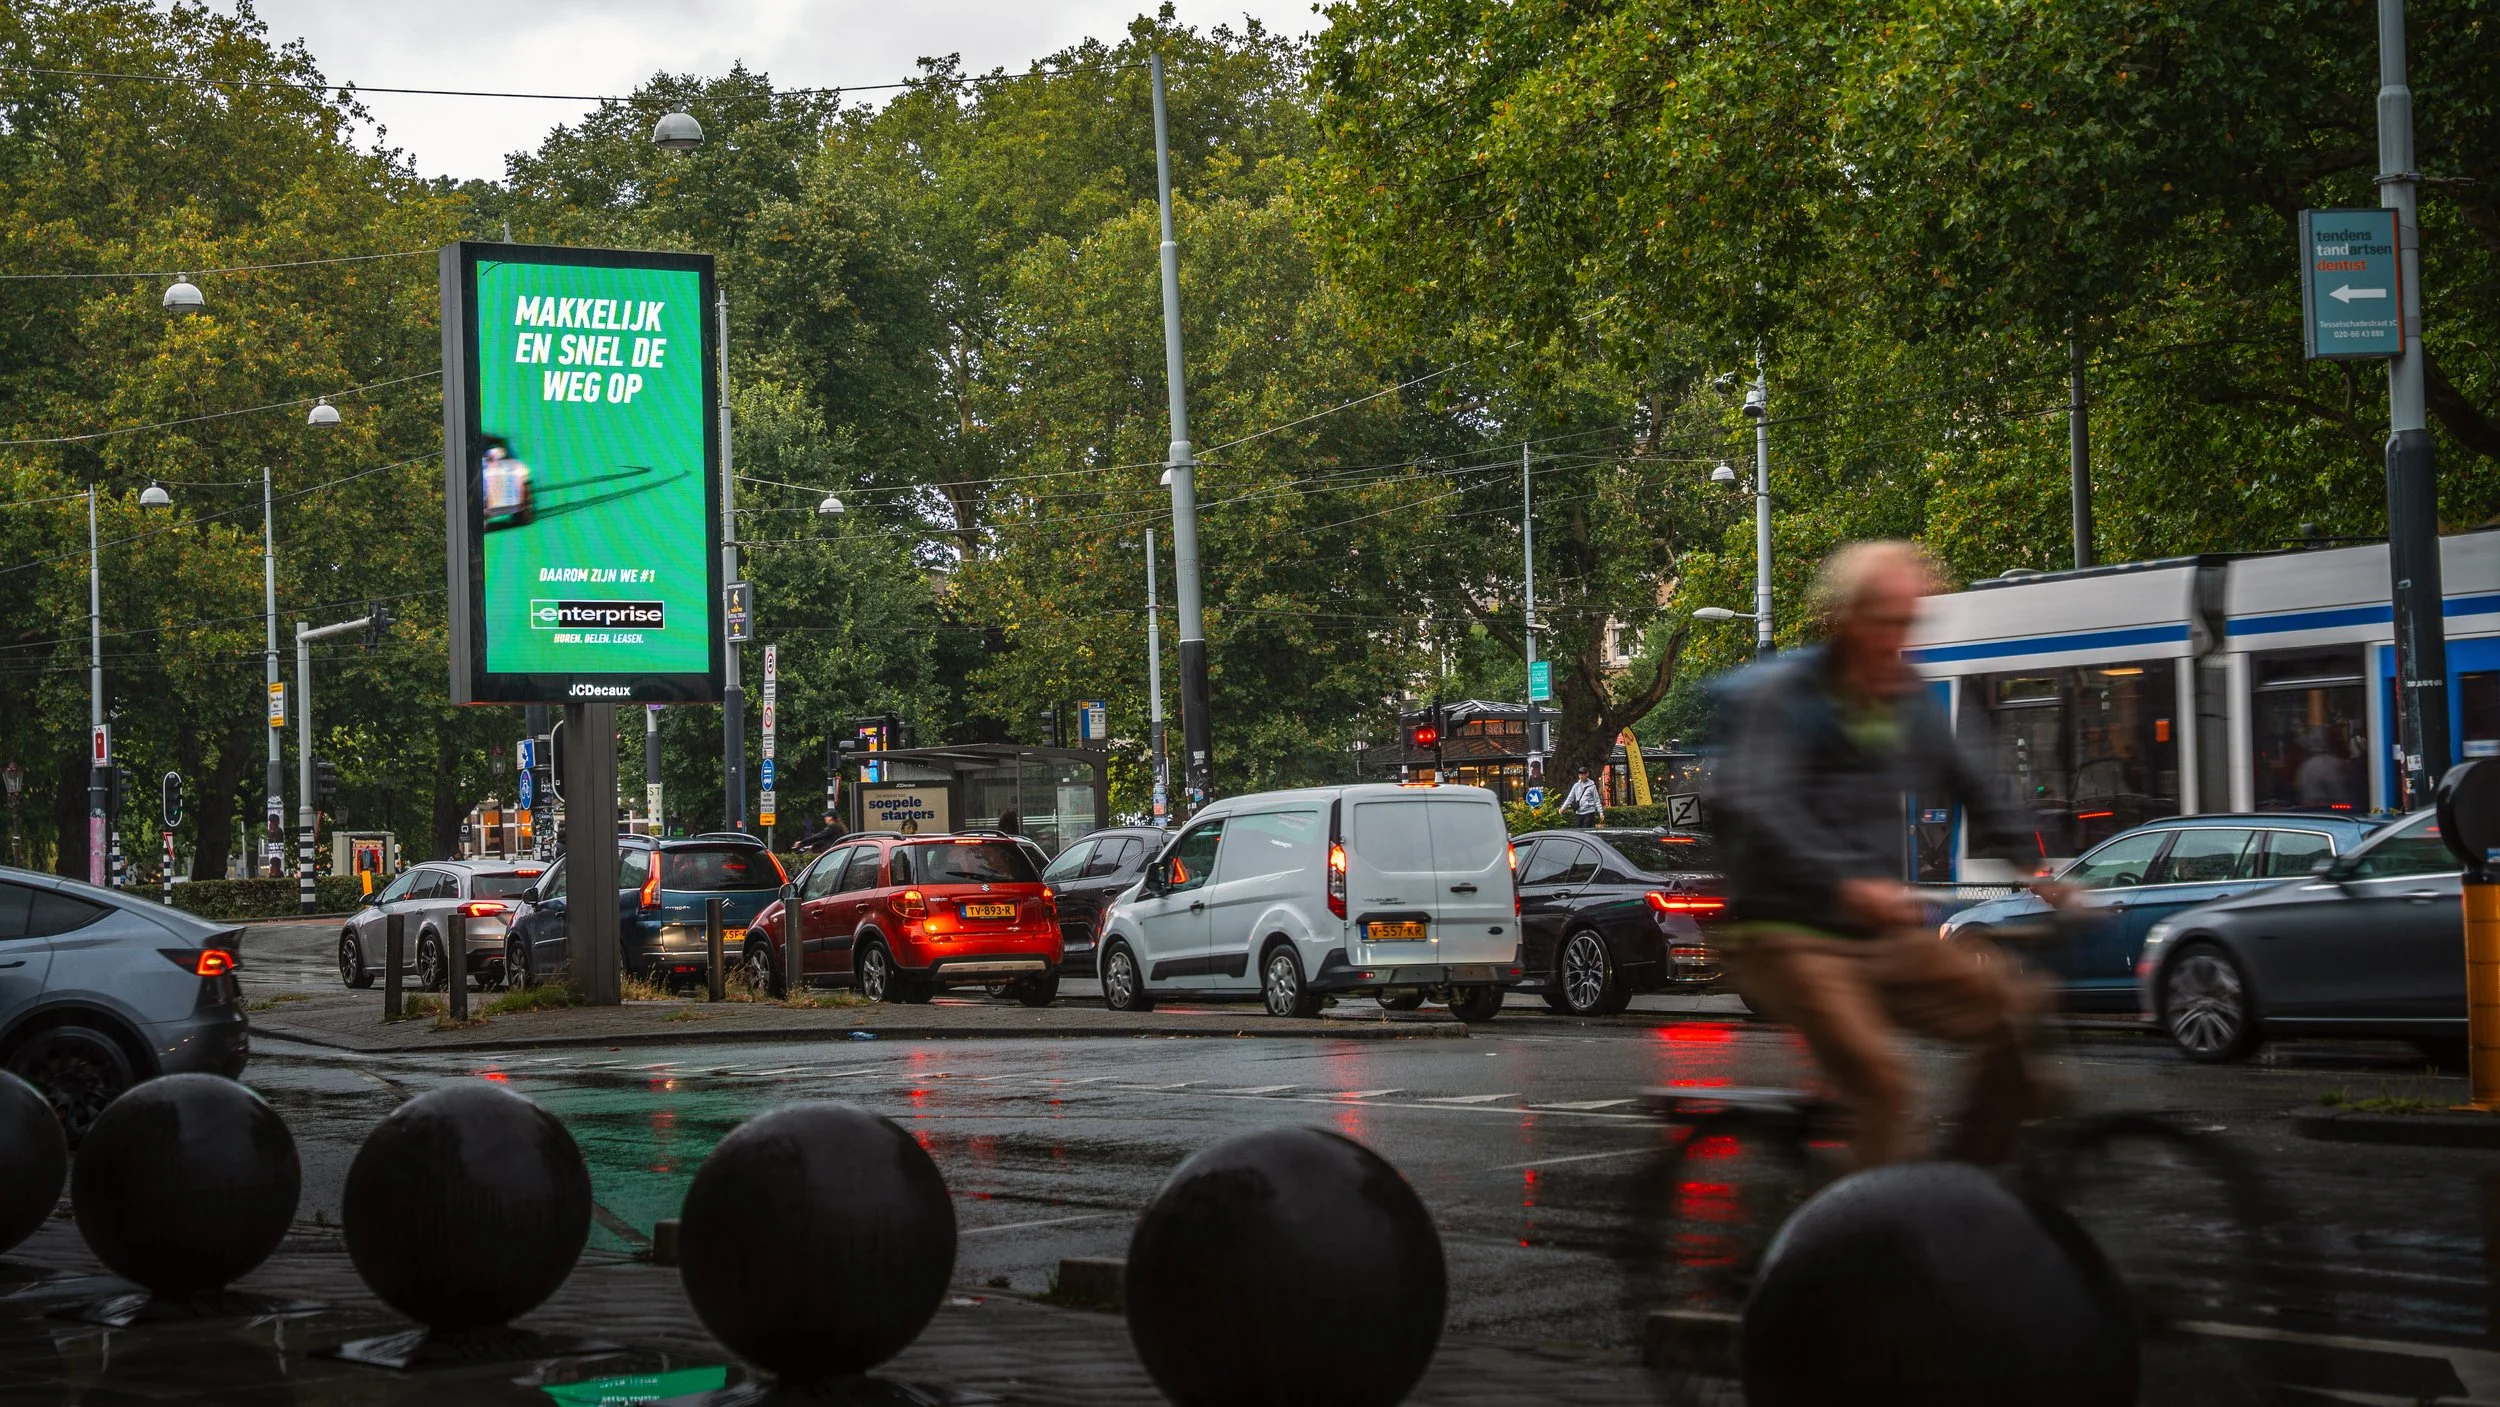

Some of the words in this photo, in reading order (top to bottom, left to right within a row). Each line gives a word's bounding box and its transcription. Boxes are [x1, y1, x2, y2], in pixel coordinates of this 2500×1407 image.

[2316, 228, 2372, 242] tendens
[2316, 243, 2392, 256] tandartsen
[2316, 259, 2367, 271] dentist
[514, 295, 665, 332] MAKKELIJK
[2320, 320, 2388, 328] Tesselschadestraat
[515, 333, 552, 363] EN
[558, 334, 624, 366] SNEL
[631, 337, 667, 368] DE
[543, 371, 602, 403] WEG
[607, 373, 643, 404] OP
[539, 567, 589, 582] DAAROM
[590, 568, 617, 583] ZIJN
[620, 569, 639, 583] WE
[639, 569, 655, 583] #1
[540, 606, 662, 625] enterprise
[554, 633, 583, 644] HUREN.
[584, 633, 611, 644] DELEN.
[613, 633, 644, 644] LEASEN.
[568, 684, 631, 696] JCDecaux
[869, 796, 922, 810] soepele
[881, 810, 934, 820] starters
[970, 905, 1011, 916] TV-893-R
[1370, 926, 1422, 937] V-557-KR
